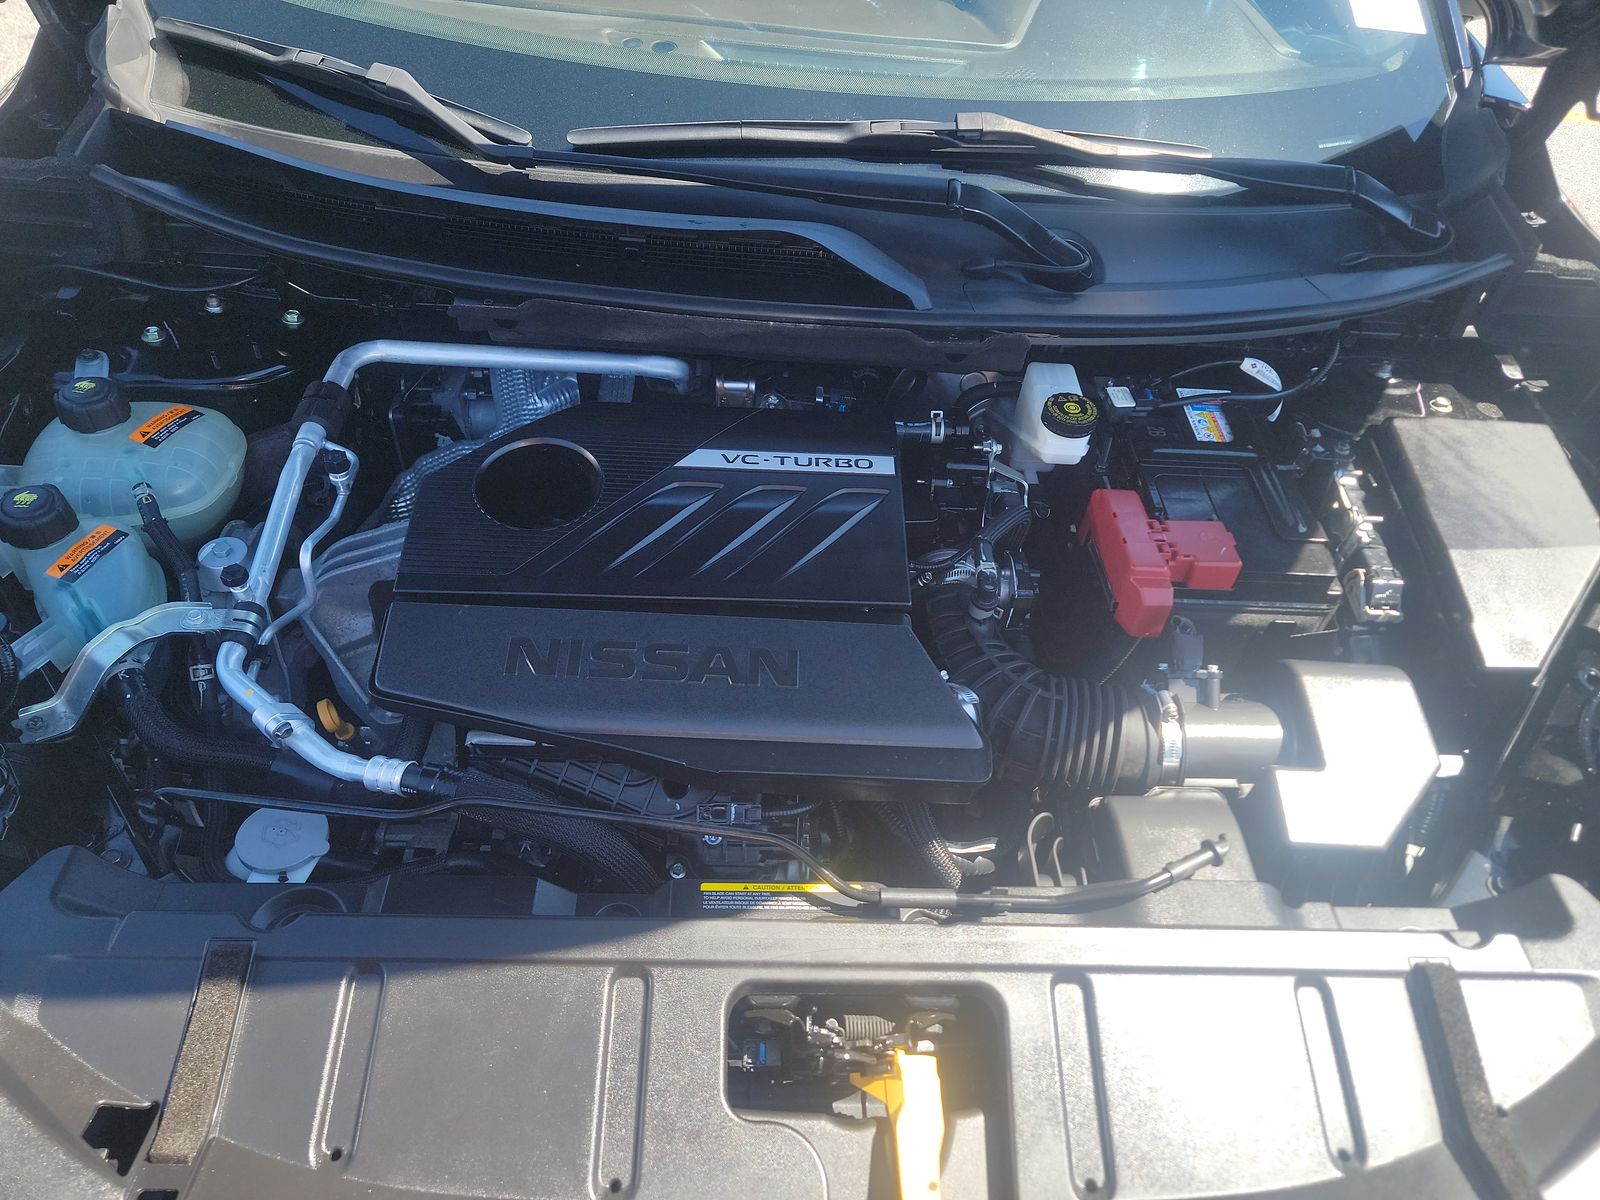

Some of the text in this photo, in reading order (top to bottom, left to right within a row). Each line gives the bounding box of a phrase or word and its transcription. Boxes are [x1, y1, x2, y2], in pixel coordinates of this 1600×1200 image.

[720, 453, 874, 470] VC-TURBO
[65, 541, 89, 560] WARNING
[503, 637, 799, 688] NISSAN
